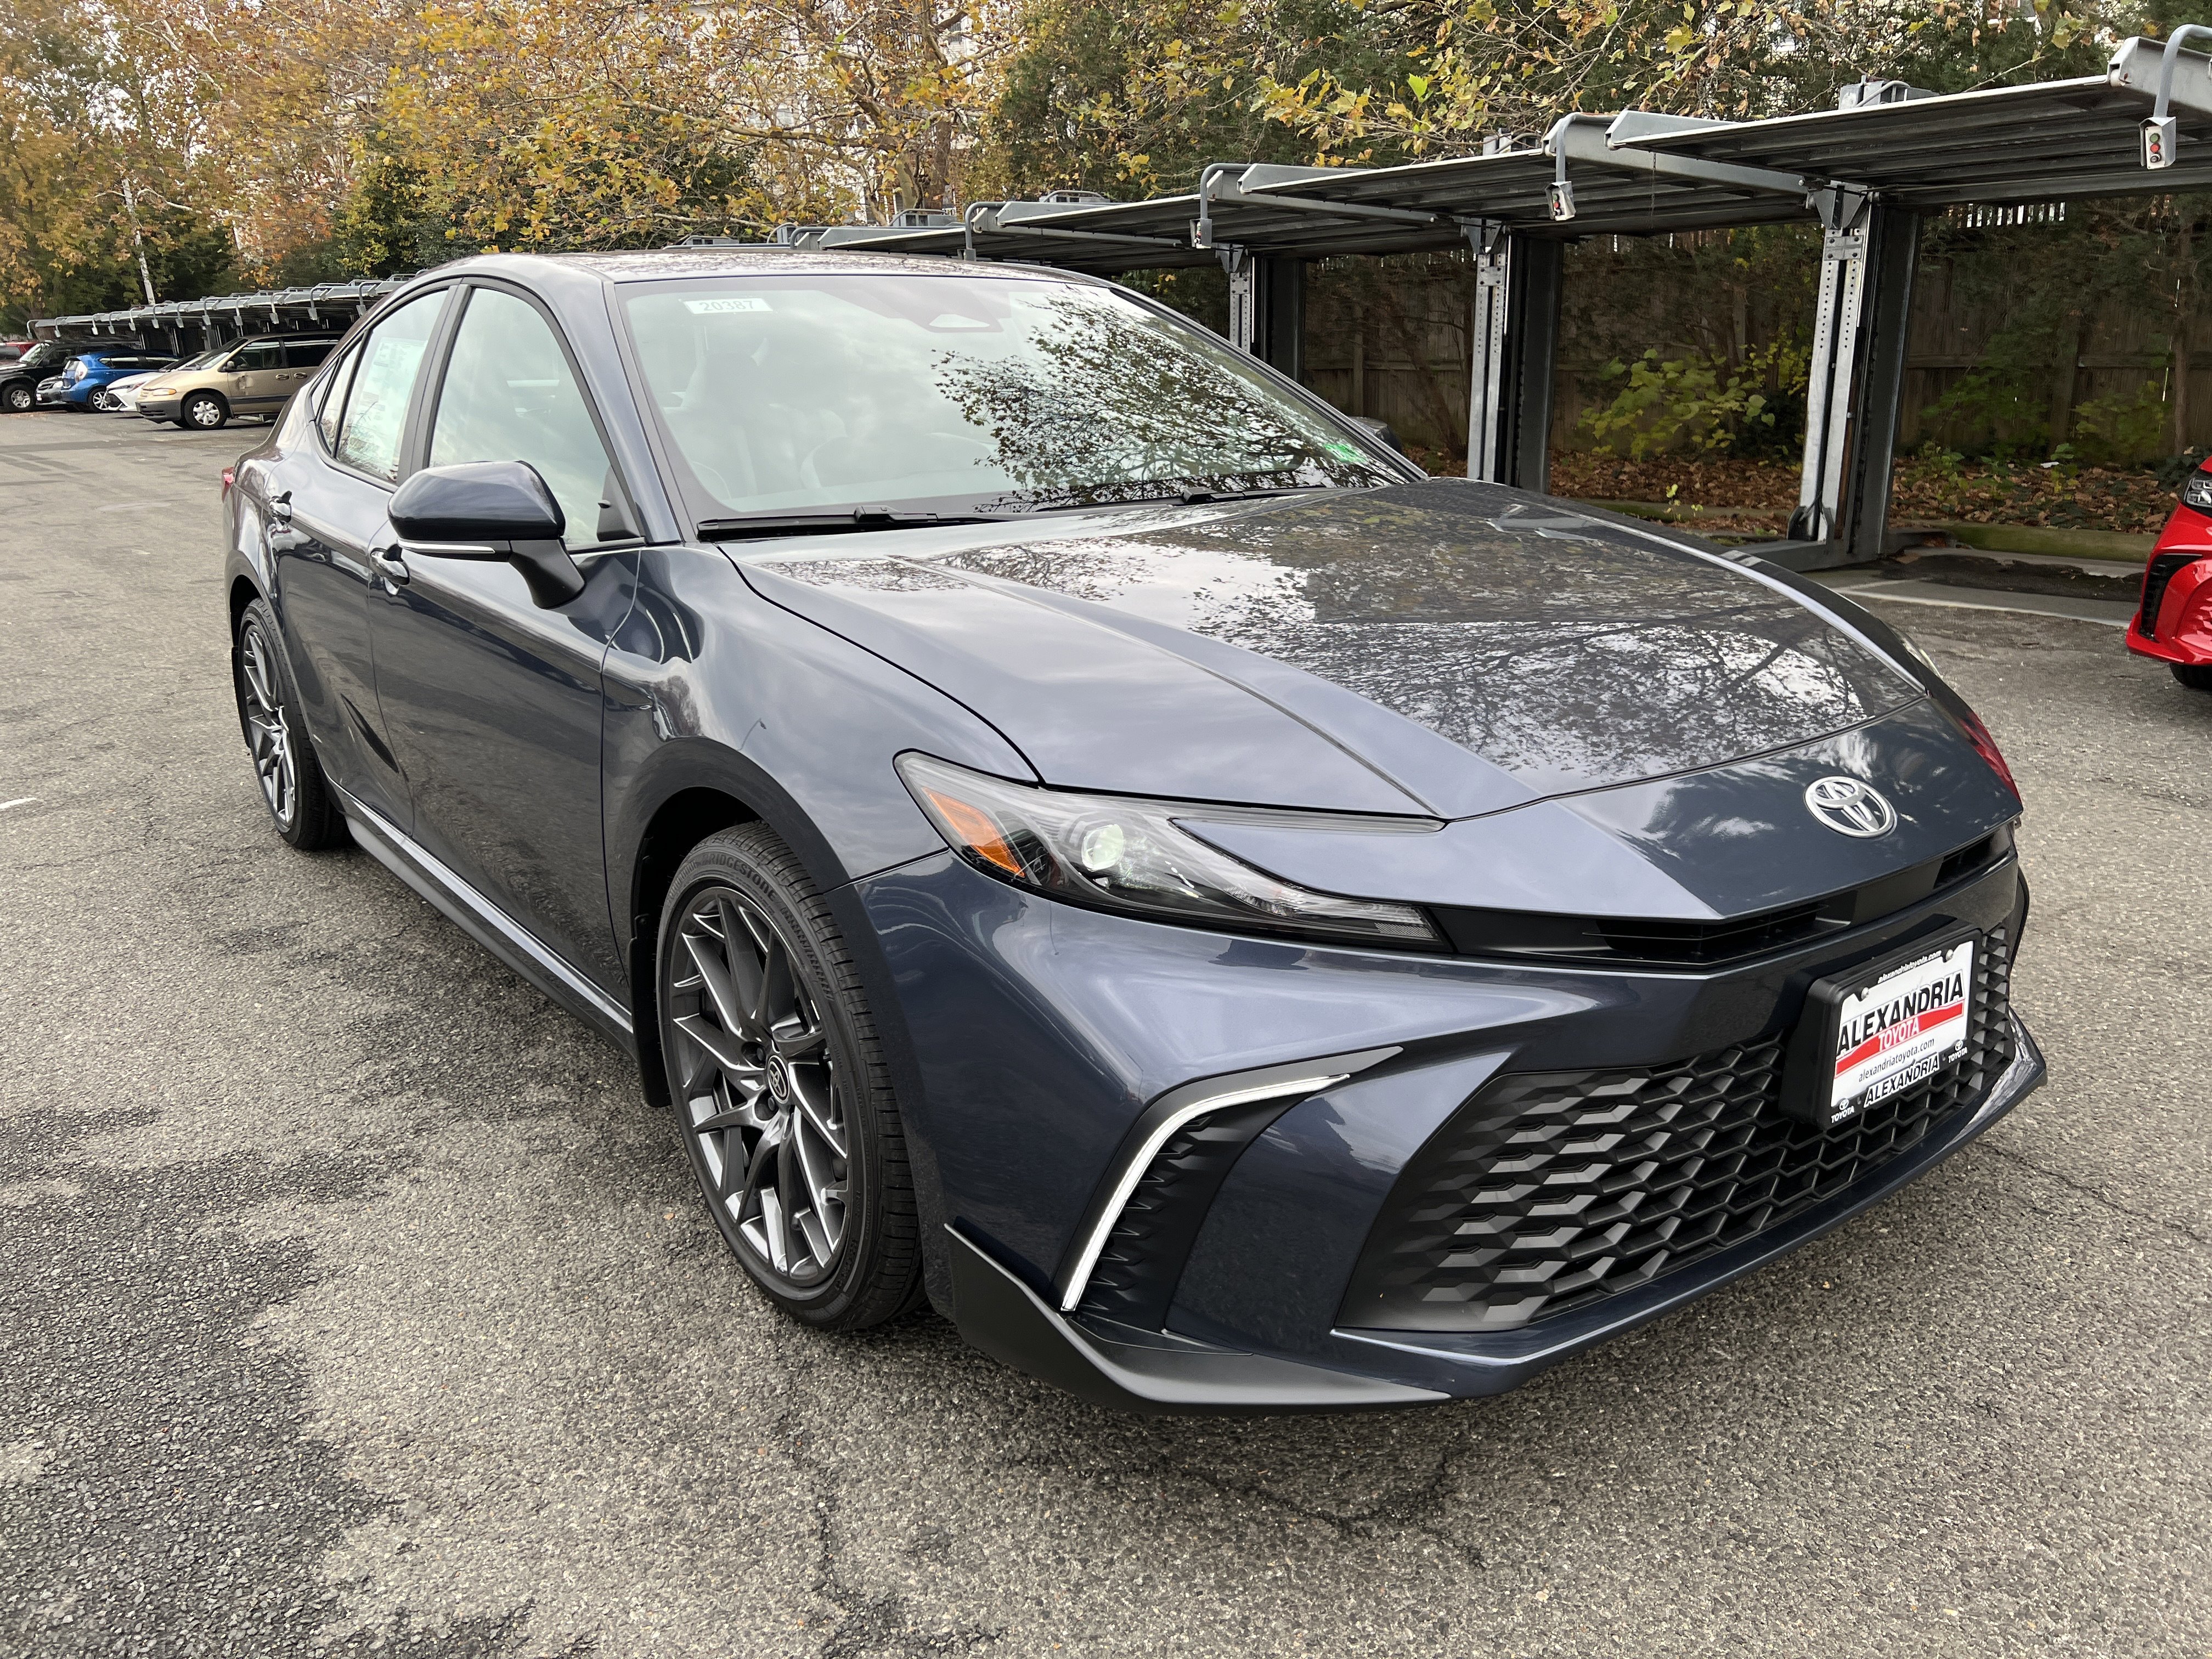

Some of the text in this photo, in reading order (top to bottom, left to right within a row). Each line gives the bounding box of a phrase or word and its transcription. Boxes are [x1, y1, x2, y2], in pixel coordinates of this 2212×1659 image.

[699, 300, 754, 311] 20387
[702, 853, 778, 902] BRIDGESTONE
[1877, 950, 1942, 984] alexandriatoyota.com
[1836, 973, 1964, 1056] ALEXANDRIA
[1878, 1018, 1920, 1052] TOYOTA
[1858, 1038, 1935, 1082] alexandriatoyota.com
[1948, 1046, 1968, 1064] TOYOTA
[1864, 1053, 1940, 1108] ALEXANDRIA
[1831, 1106, 1855, 1124] TOYOTA
